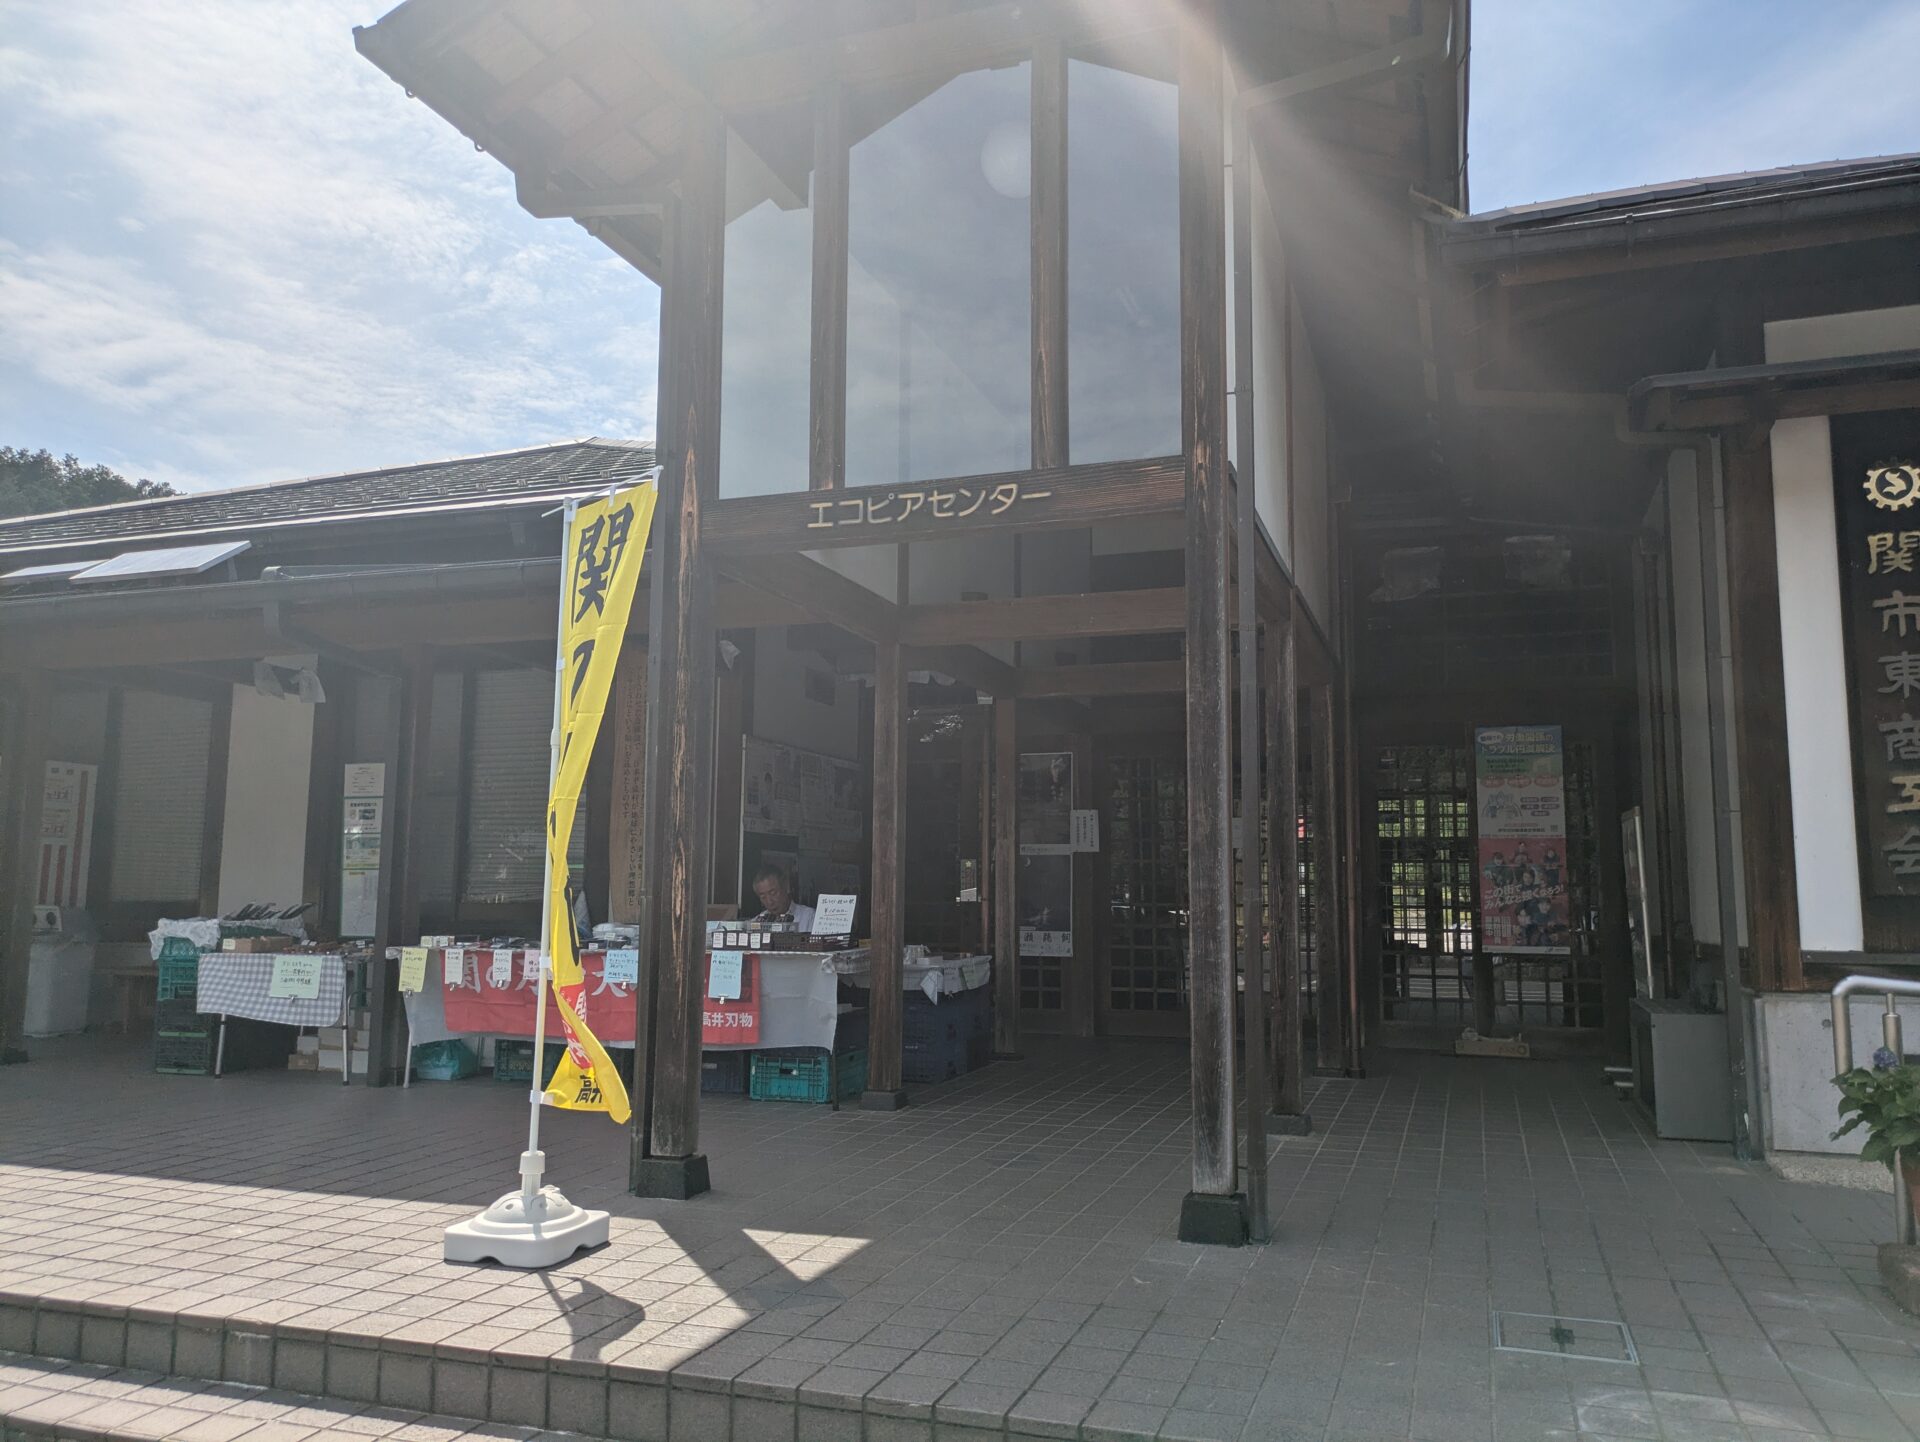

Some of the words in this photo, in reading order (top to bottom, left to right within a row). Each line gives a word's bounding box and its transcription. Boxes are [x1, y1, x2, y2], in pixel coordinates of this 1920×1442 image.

[807, 484, 1052, 528] エコピアセンター
[1867, 531, 1920, 876] 関市東商工会
[702, 1012, 754, 1029] 高井刃物
